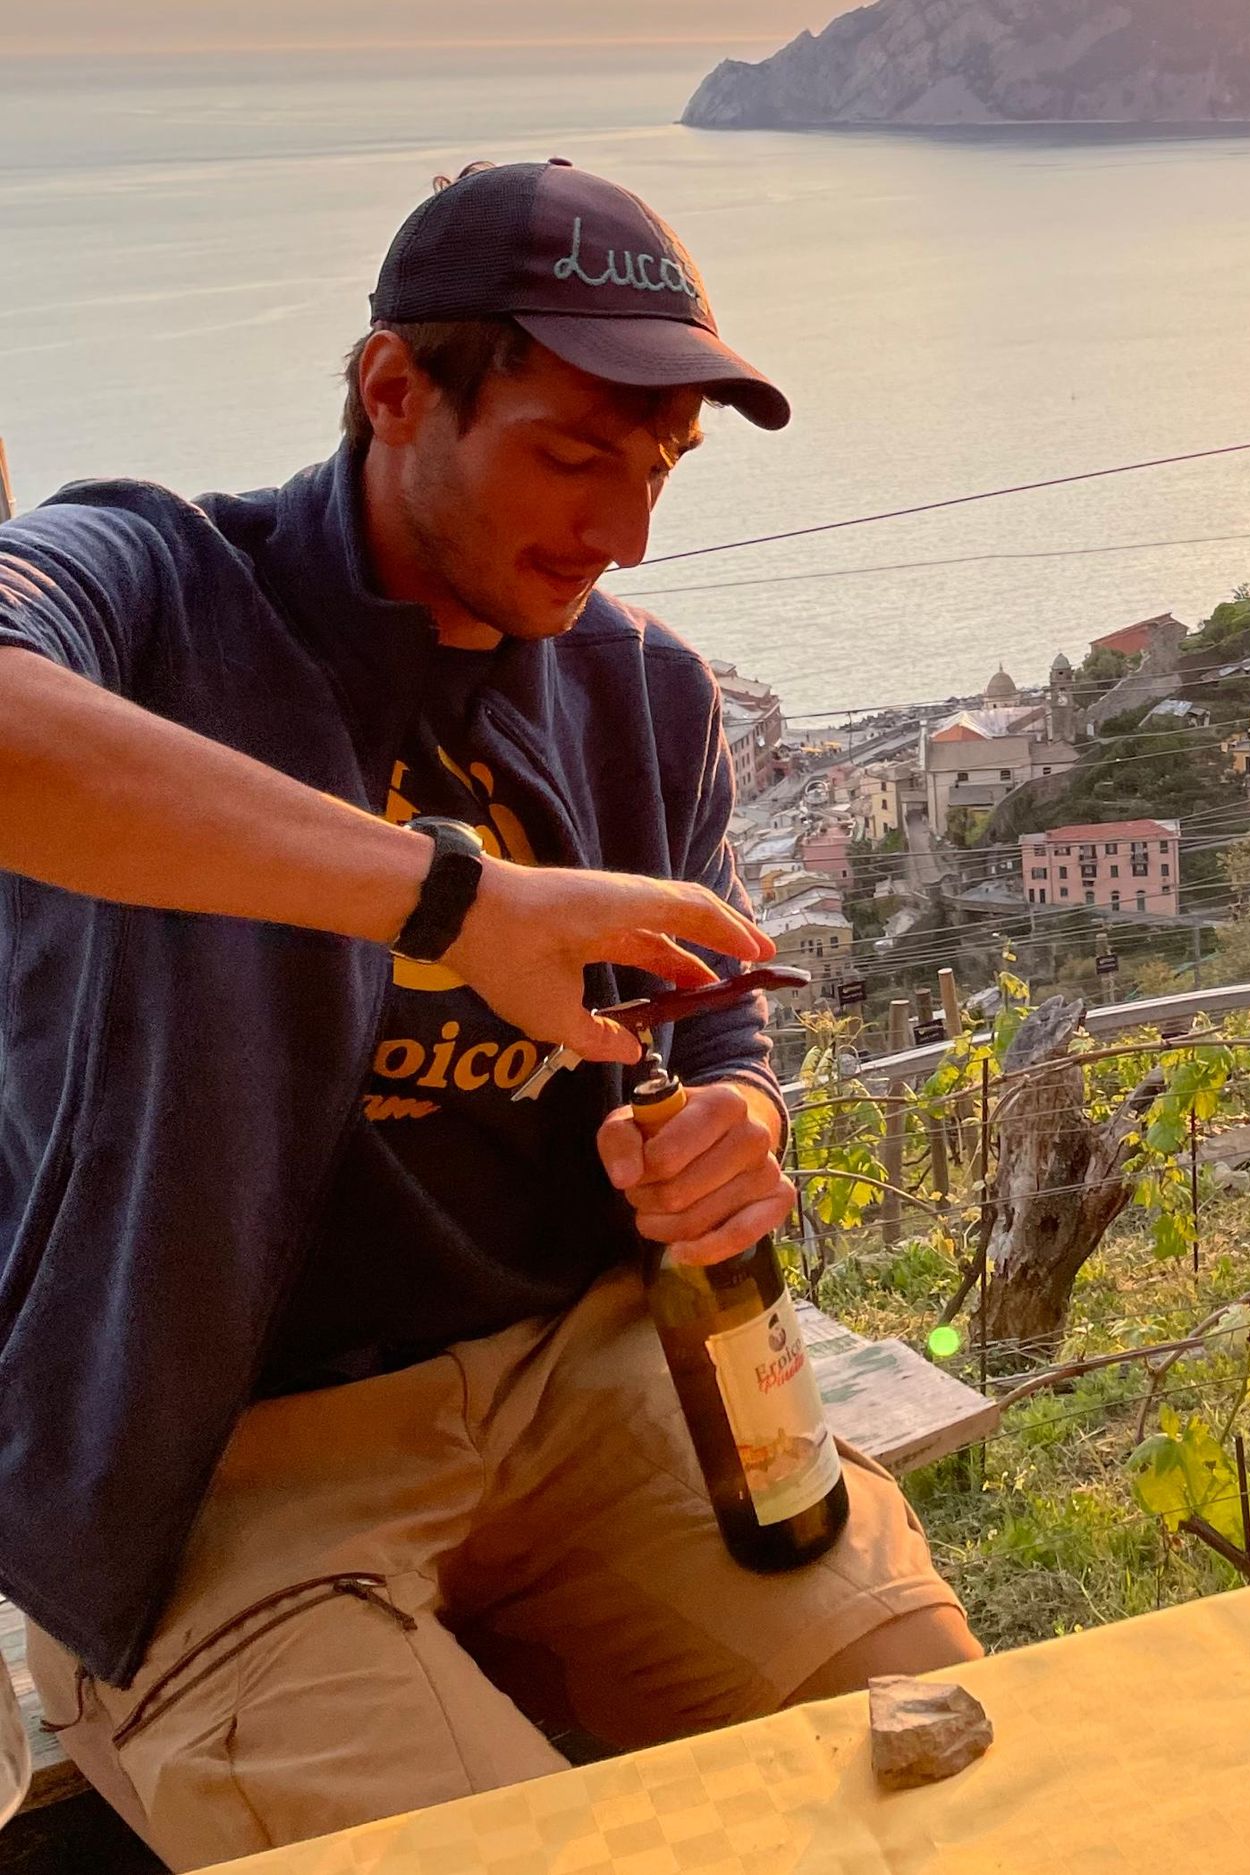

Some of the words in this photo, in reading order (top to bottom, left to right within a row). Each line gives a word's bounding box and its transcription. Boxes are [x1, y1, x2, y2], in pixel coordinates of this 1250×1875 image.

[553, 216, 696, 298] Luca
[373, 1020, 537, 1091] oico
[755, 1337, 802, 1383] Eroico
